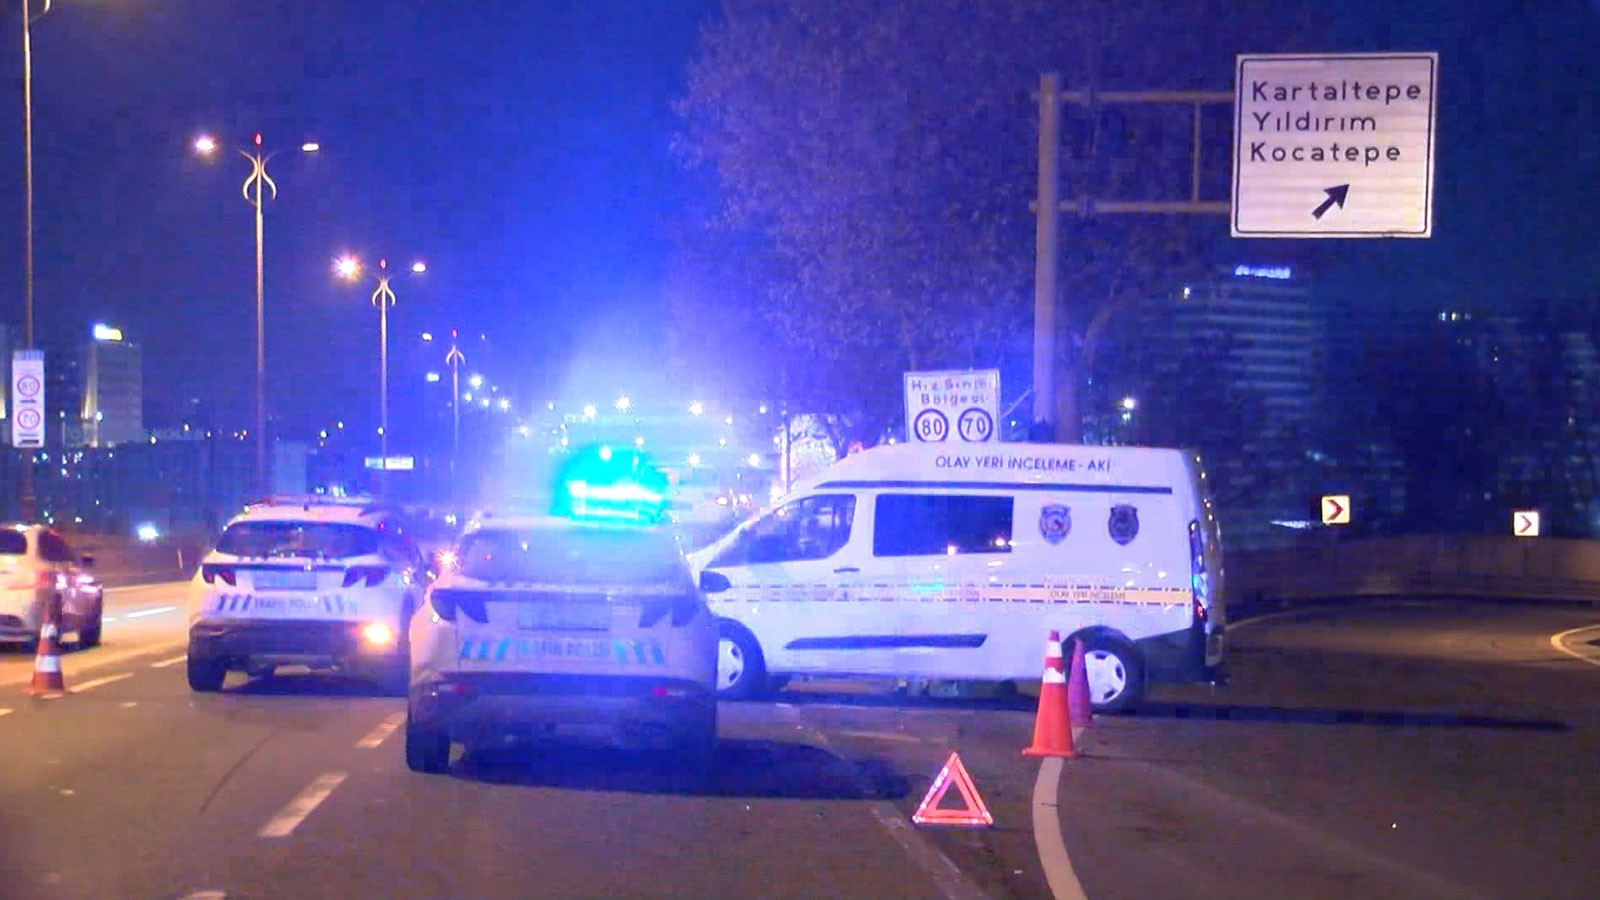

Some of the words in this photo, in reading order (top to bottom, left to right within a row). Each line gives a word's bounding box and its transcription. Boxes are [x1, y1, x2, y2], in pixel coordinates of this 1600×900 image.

[1252, 80, 1421, 105] Kartaltepe
[1253, 111, 1376, 131] Yıldırım
[1250, 142, 1401, 167] Kocatepe
[922, 418, 942, 436] 80
[964, 418, 986, 435] 70
[935, 455, 970, 468] OLAY
